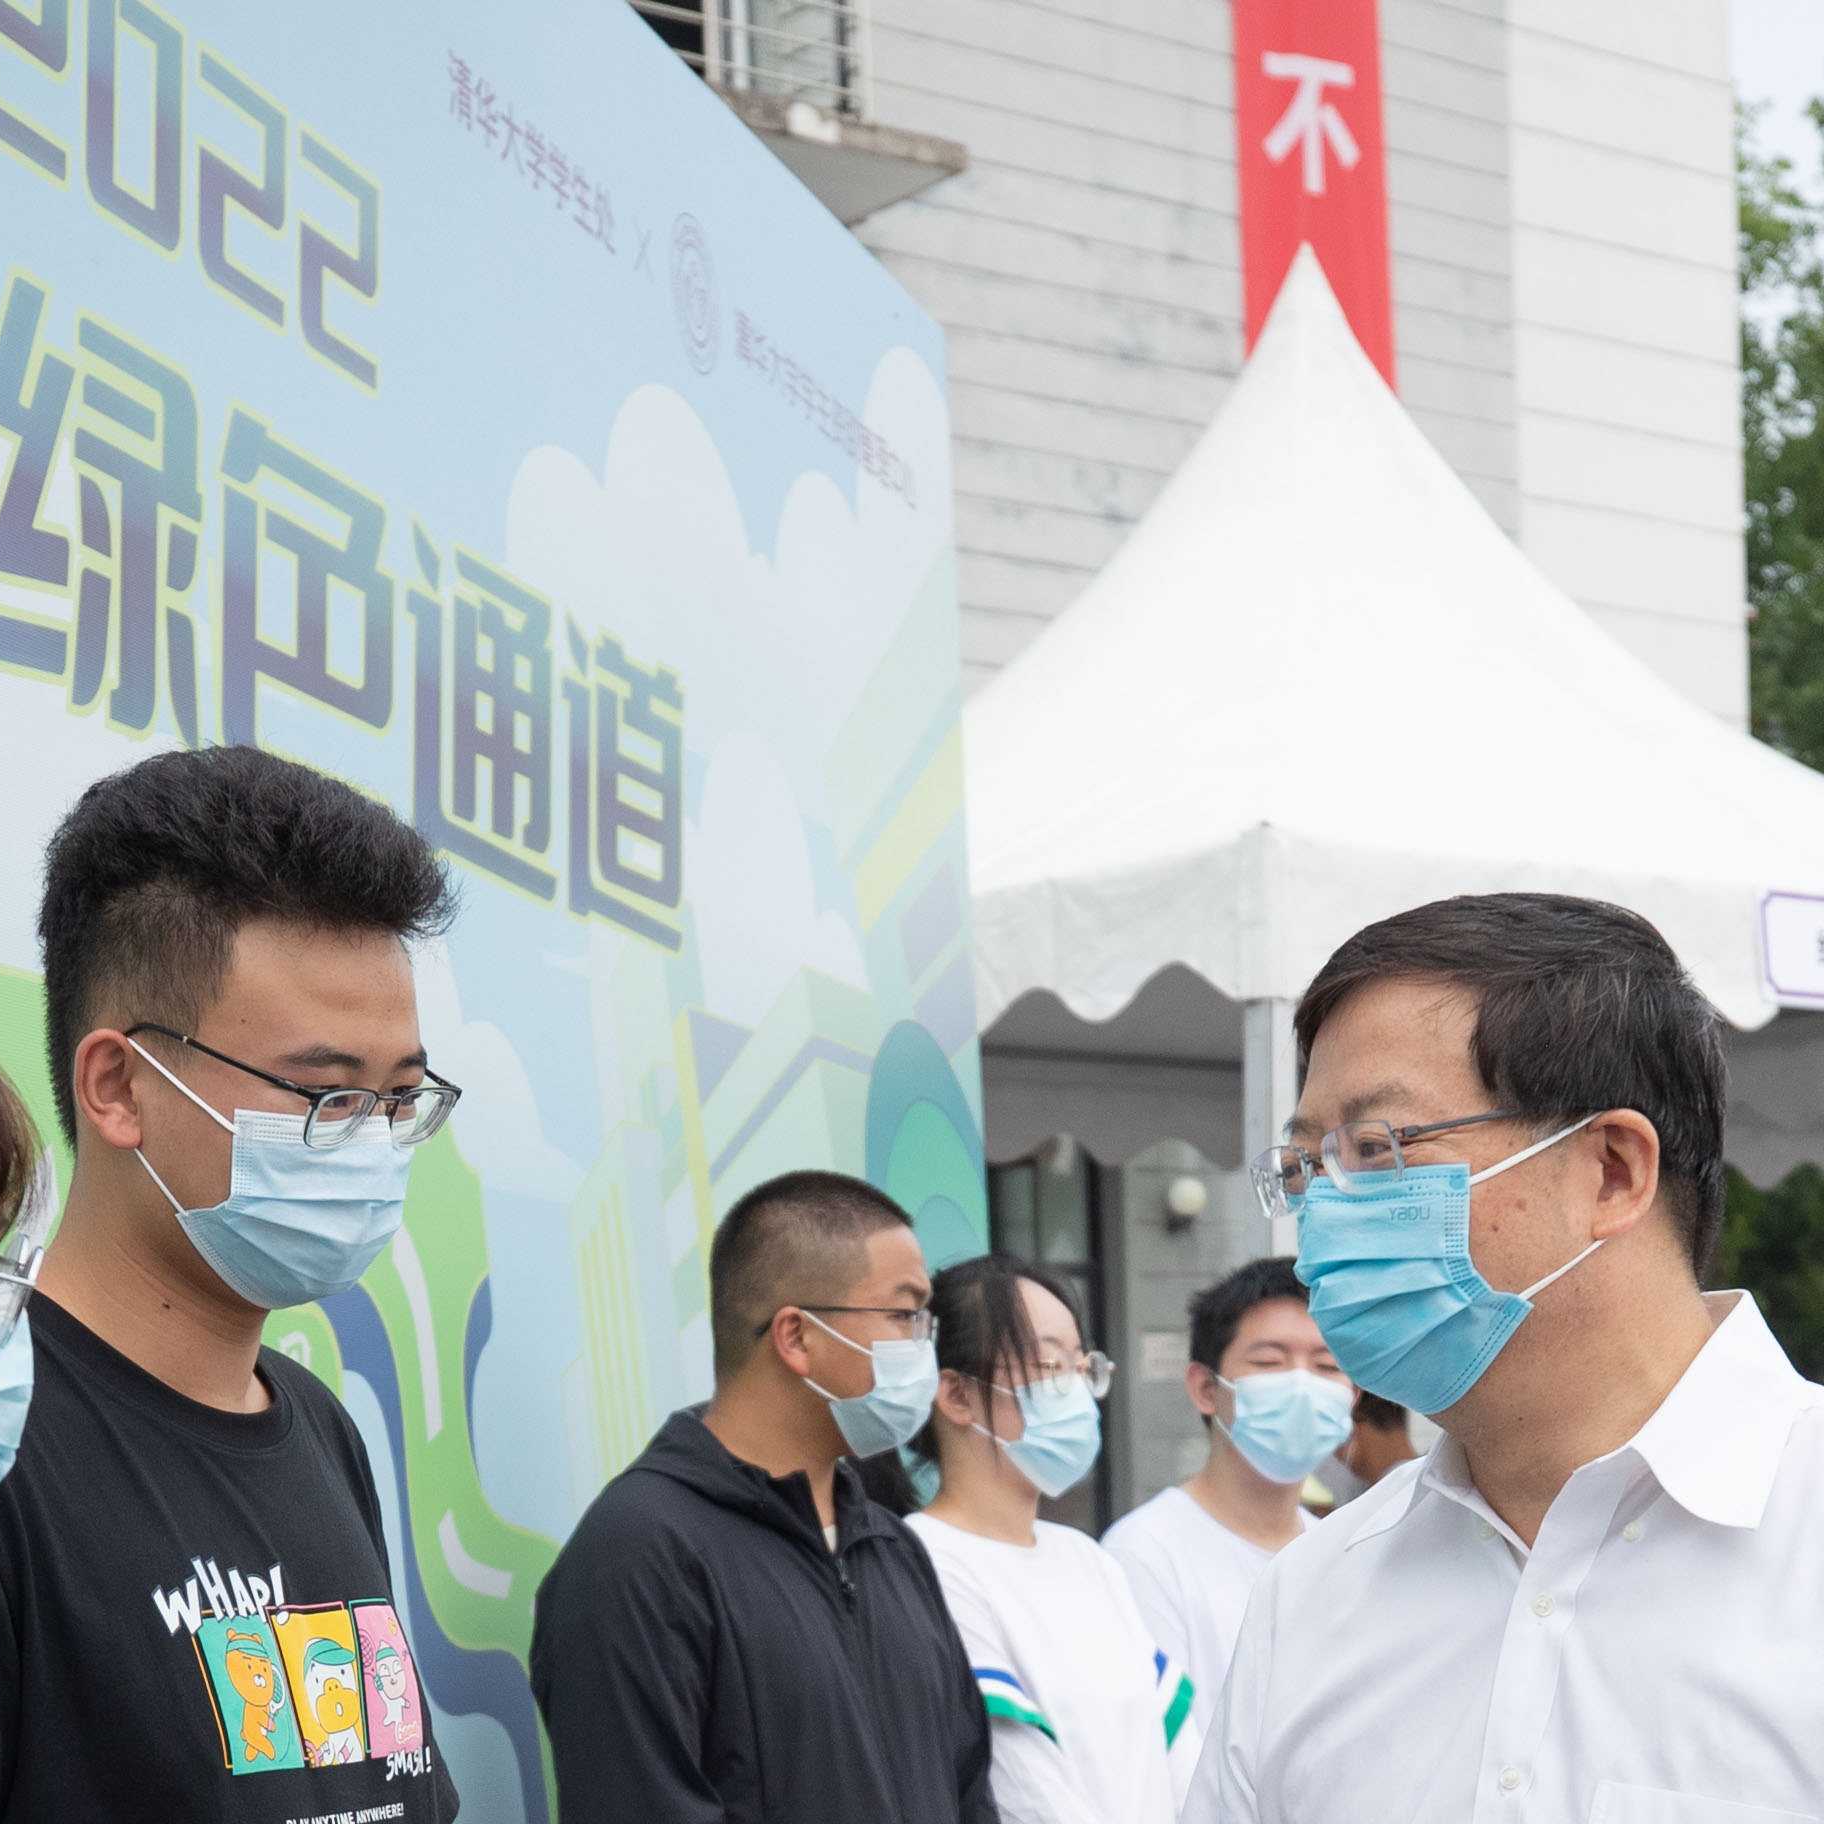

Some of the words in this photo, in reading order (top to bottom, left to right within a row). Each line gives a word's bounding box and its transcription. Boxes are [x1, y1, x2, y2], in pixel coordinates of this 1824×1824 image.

[1261, 51, 1361, 195] 不
[152, 1555, 290, 1637] WHAP!
[356, 1802, 404, 1824] ANYWHERE!
